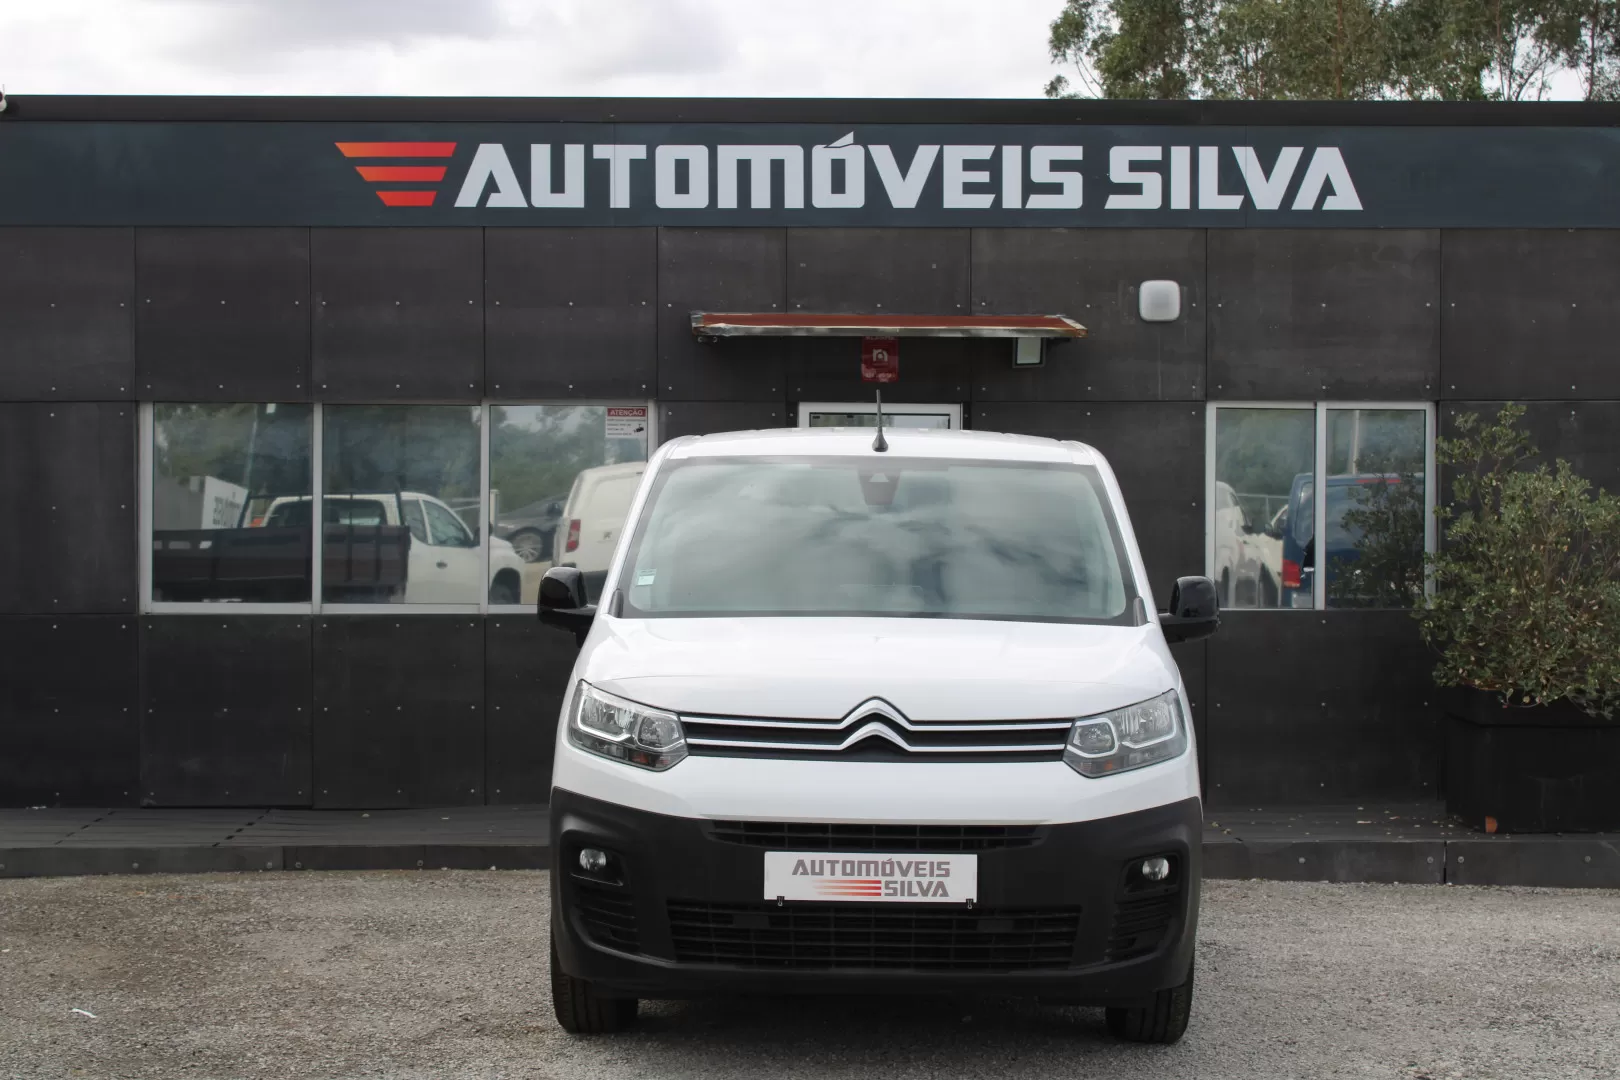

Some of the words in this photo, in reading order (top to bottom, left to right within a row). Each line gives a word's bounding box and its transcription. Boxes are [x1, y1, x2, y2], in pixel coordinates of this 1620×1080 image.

[454, 131, 1084, 209] AUTOMÓVEIS
[1104, 145, 1364, 210] SILVA
[610, 407, 643, 417] ATENÇÃO
[791, 858, 950, 878] AUTOMÓVEIS
[884, 880, 949, 897] SILVA
